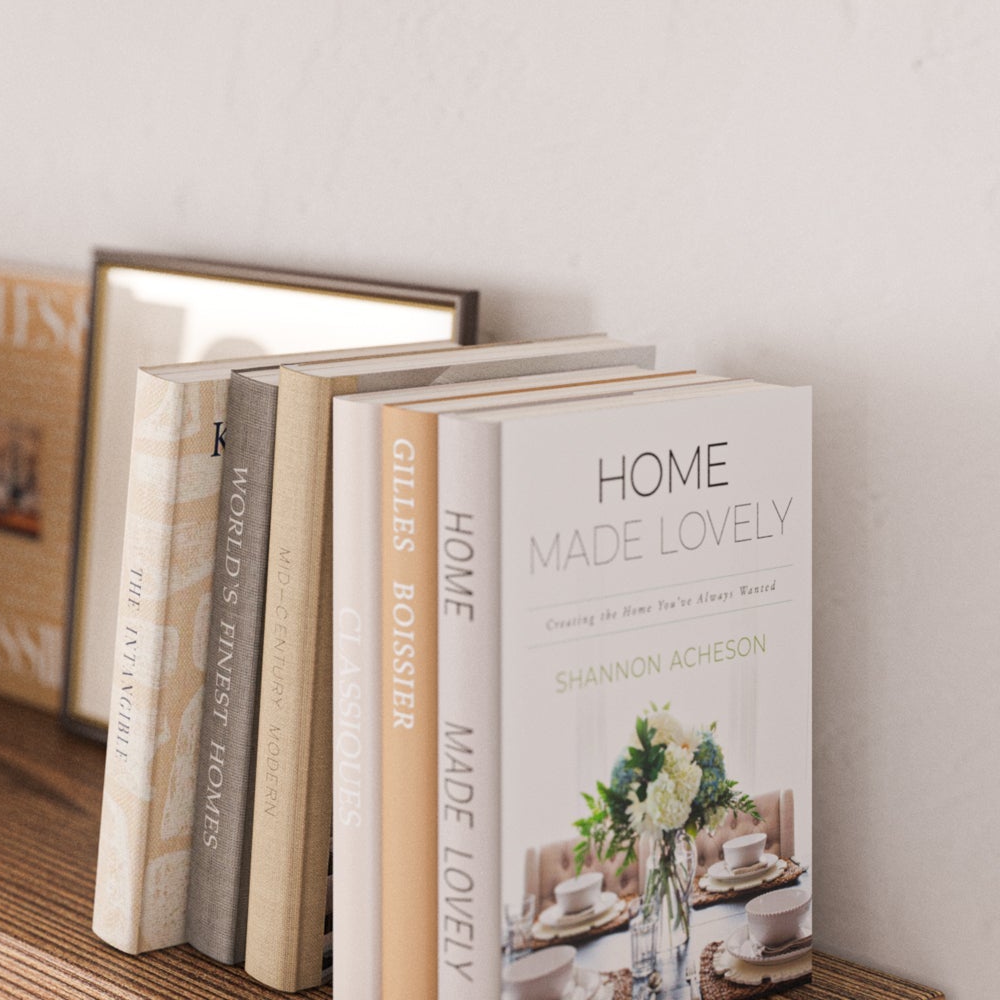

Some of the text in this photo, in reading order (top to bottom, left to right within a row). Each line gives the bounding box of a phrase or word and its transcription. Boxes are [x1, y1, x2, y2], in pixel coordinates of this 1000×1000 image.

[529, 496, 793, 576] MADE LOVELY
[599, 441, 729, 503] HOME
[115, 567, 144, 764] THE INTANGIBLE
[203, 466, 249, 850] WORLD'S FINEST HOMES
[264, 546, 292, 818] MID-CENTURY MODERN
[392, 438, 416, 730] GILLES BOISSIER
[545, 612, 595, 632] Creating
[600, 608, 618, 622] the
[622, 603, 653, 618] Home
[696, 589, 735, 604] Always
[739, 579, 777, 597] Wanted
[555, 633, 767, 695] SHANNON ACHESON
[337, 606, 363, 828] CLASSIQUES
[443, 509, 475, 984] HOME MADE LOVELY
